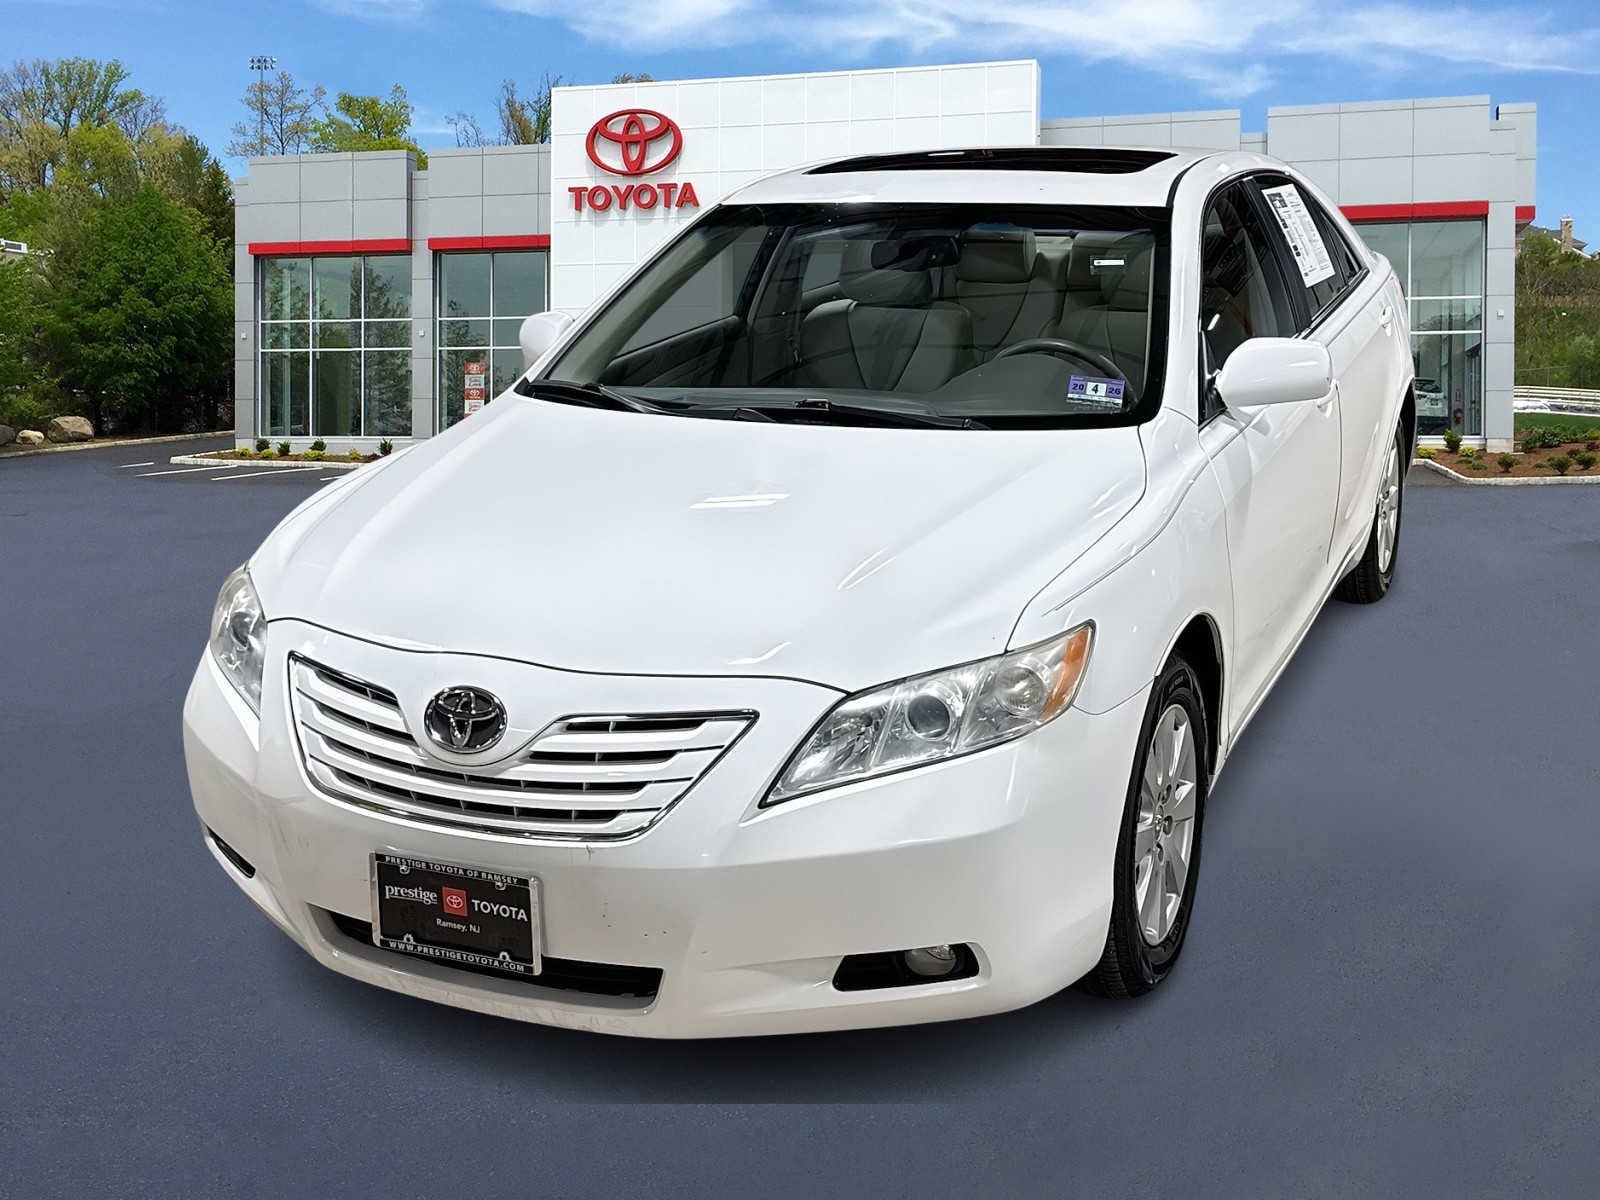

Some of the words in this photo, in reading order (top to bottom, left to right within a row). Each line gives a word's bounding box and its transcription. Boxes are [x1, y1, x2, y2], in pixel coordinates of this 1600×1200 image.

[568, 182, 699, 212] TOYOTA
[1091, 383, 1099, 394] 4
[385, 855, 427, 869] PRESTIGE
[429, 864, 464, 875] TOYOTA
[466, 869, 479, 877] OF
[481, 872, 518, 884] RAMSEY
[384, 884, 438, 905] prestige
[471, 899, 528, 922] TOYOTA
[436, 918, 468, 932] Ramsey,
[469, 924, 480, 933] NJ
[389, 940, 525, 972] WWW.PRESTIGETOYOTA.COM
